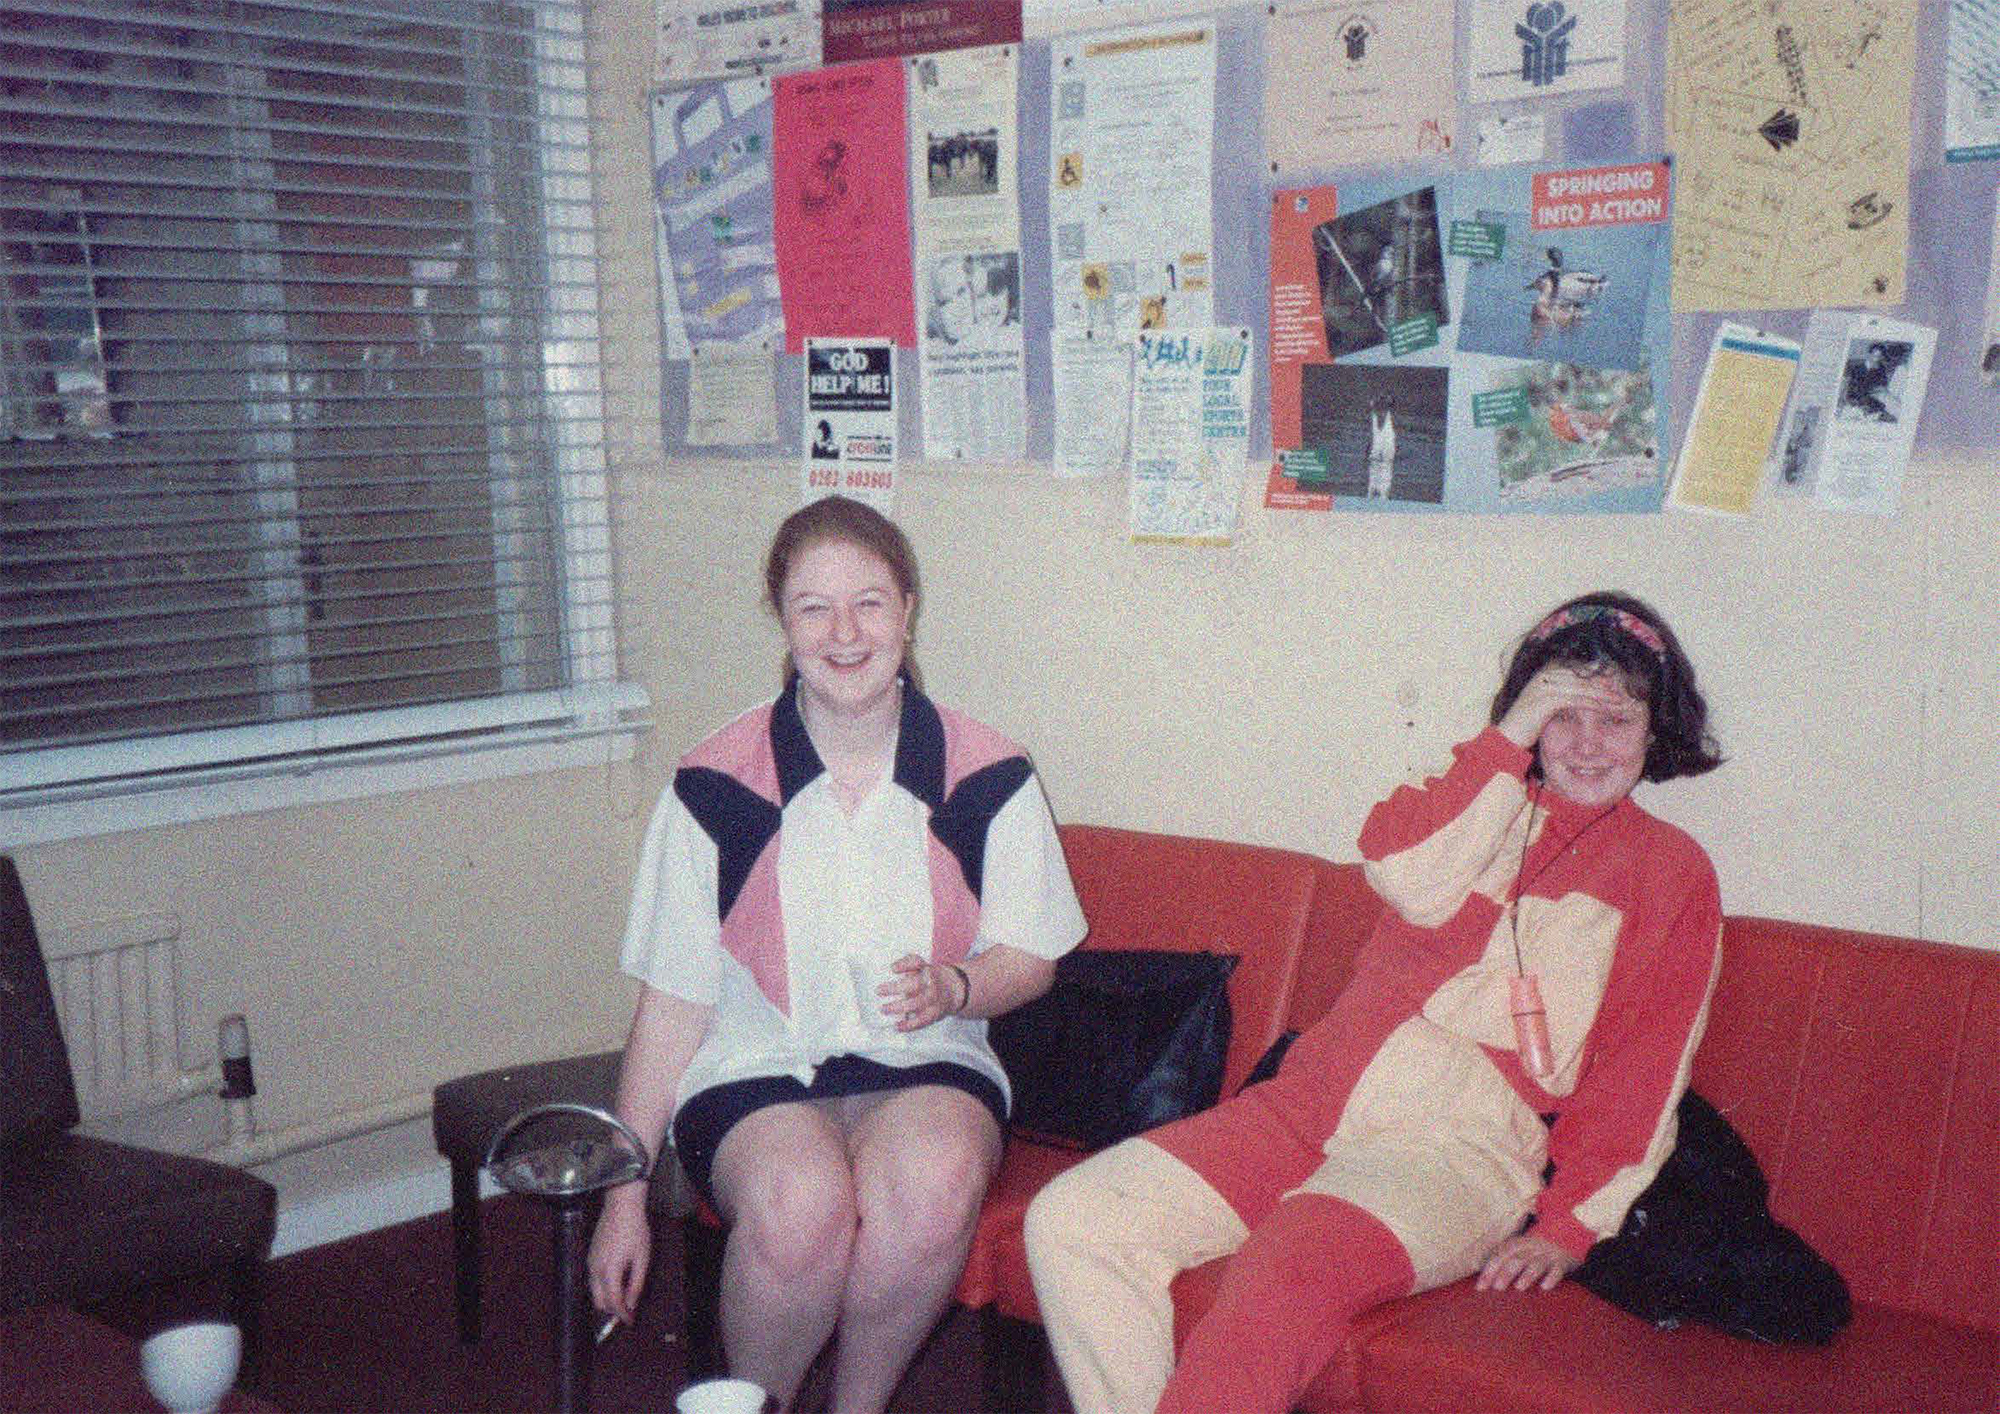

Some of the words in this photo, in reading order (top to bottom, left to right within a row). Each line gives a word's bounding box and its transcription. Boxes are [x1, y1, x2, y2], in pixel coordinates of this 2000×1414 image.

[1547, 170, 1655, 198] SPRINGING
[1538, 203, 1584, 226] INTO
[1589, 198, 1662, 221] ACTION
[829, 352, 869, 371] GOD
[811, 375, 853, 394] HELP
